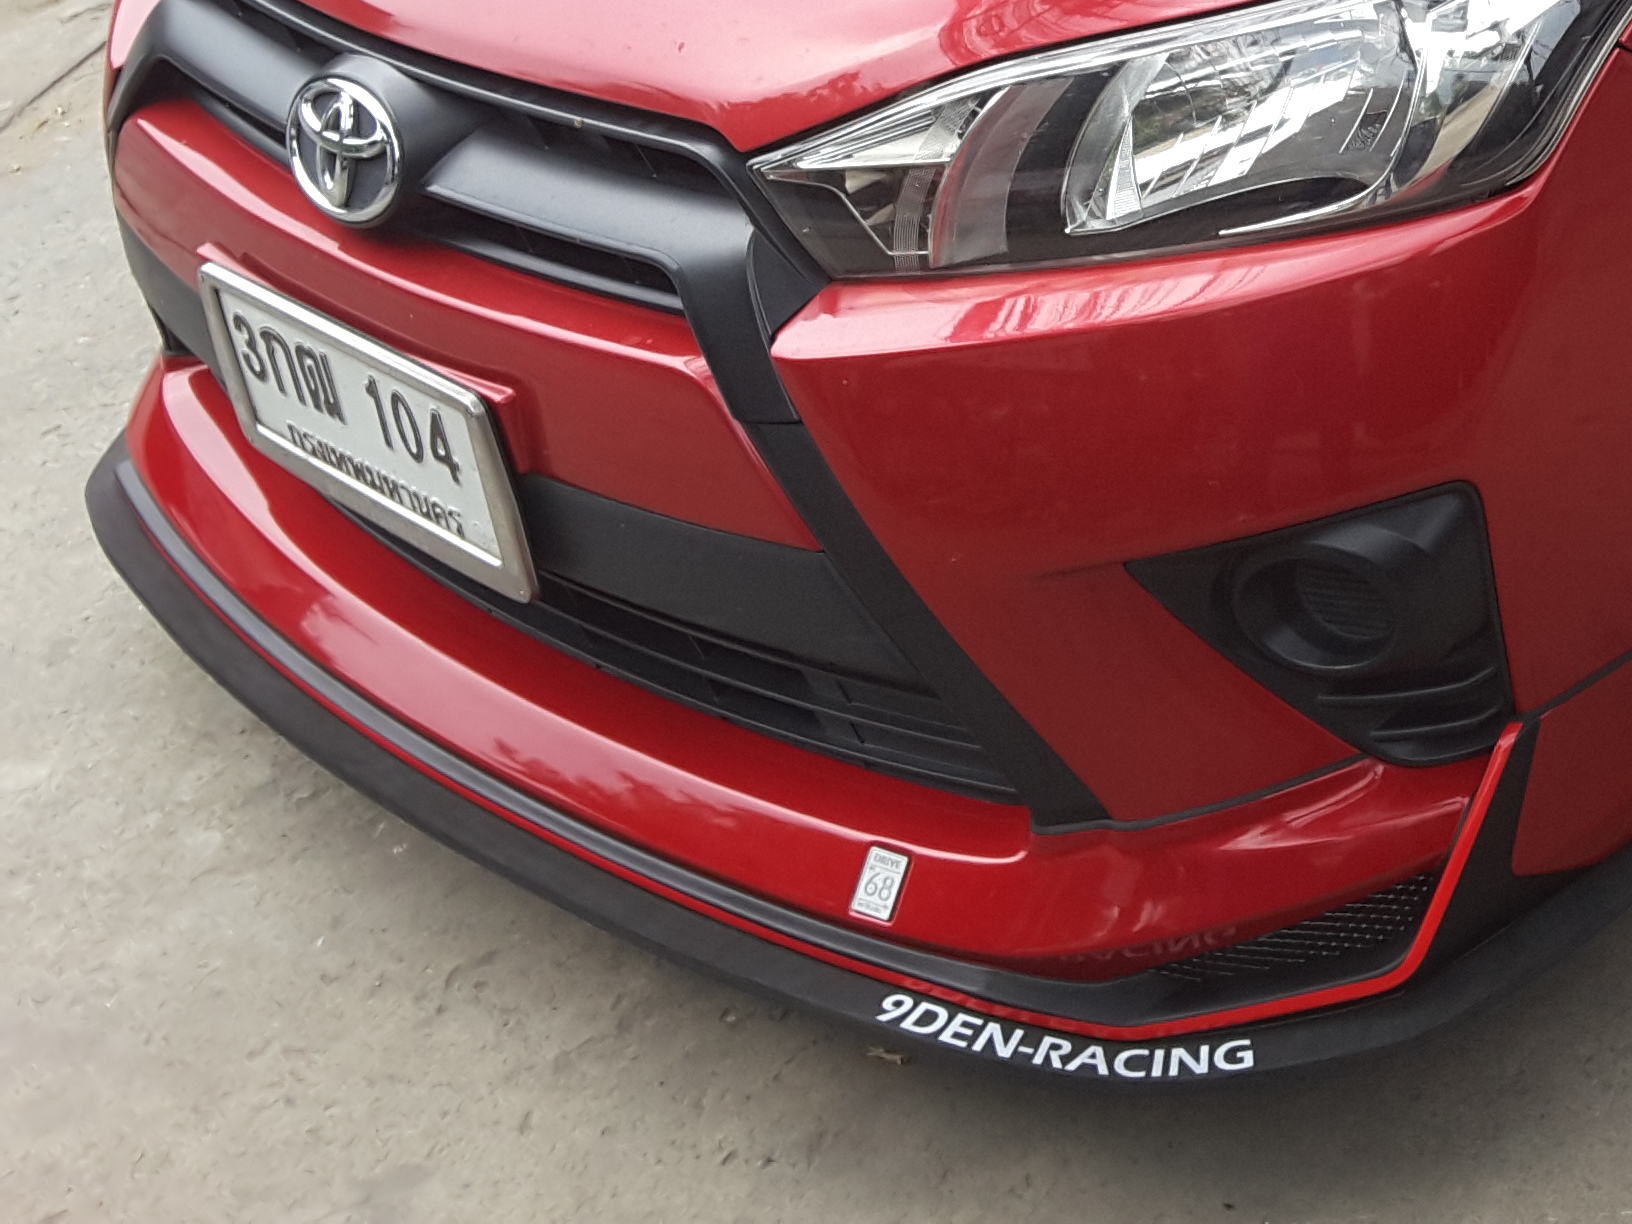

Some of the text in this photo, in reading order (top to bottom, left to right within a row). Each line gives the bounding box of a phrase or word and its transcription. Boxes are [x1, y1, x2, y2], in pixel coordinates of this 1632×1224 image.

[364, 374, 462, 485] 104
[286, 422, 464, 538] กรงเทพมหานคร
[864, 872, 895, 902] 68
[875, 993, 1255, 1078] 9DEN-RACING
